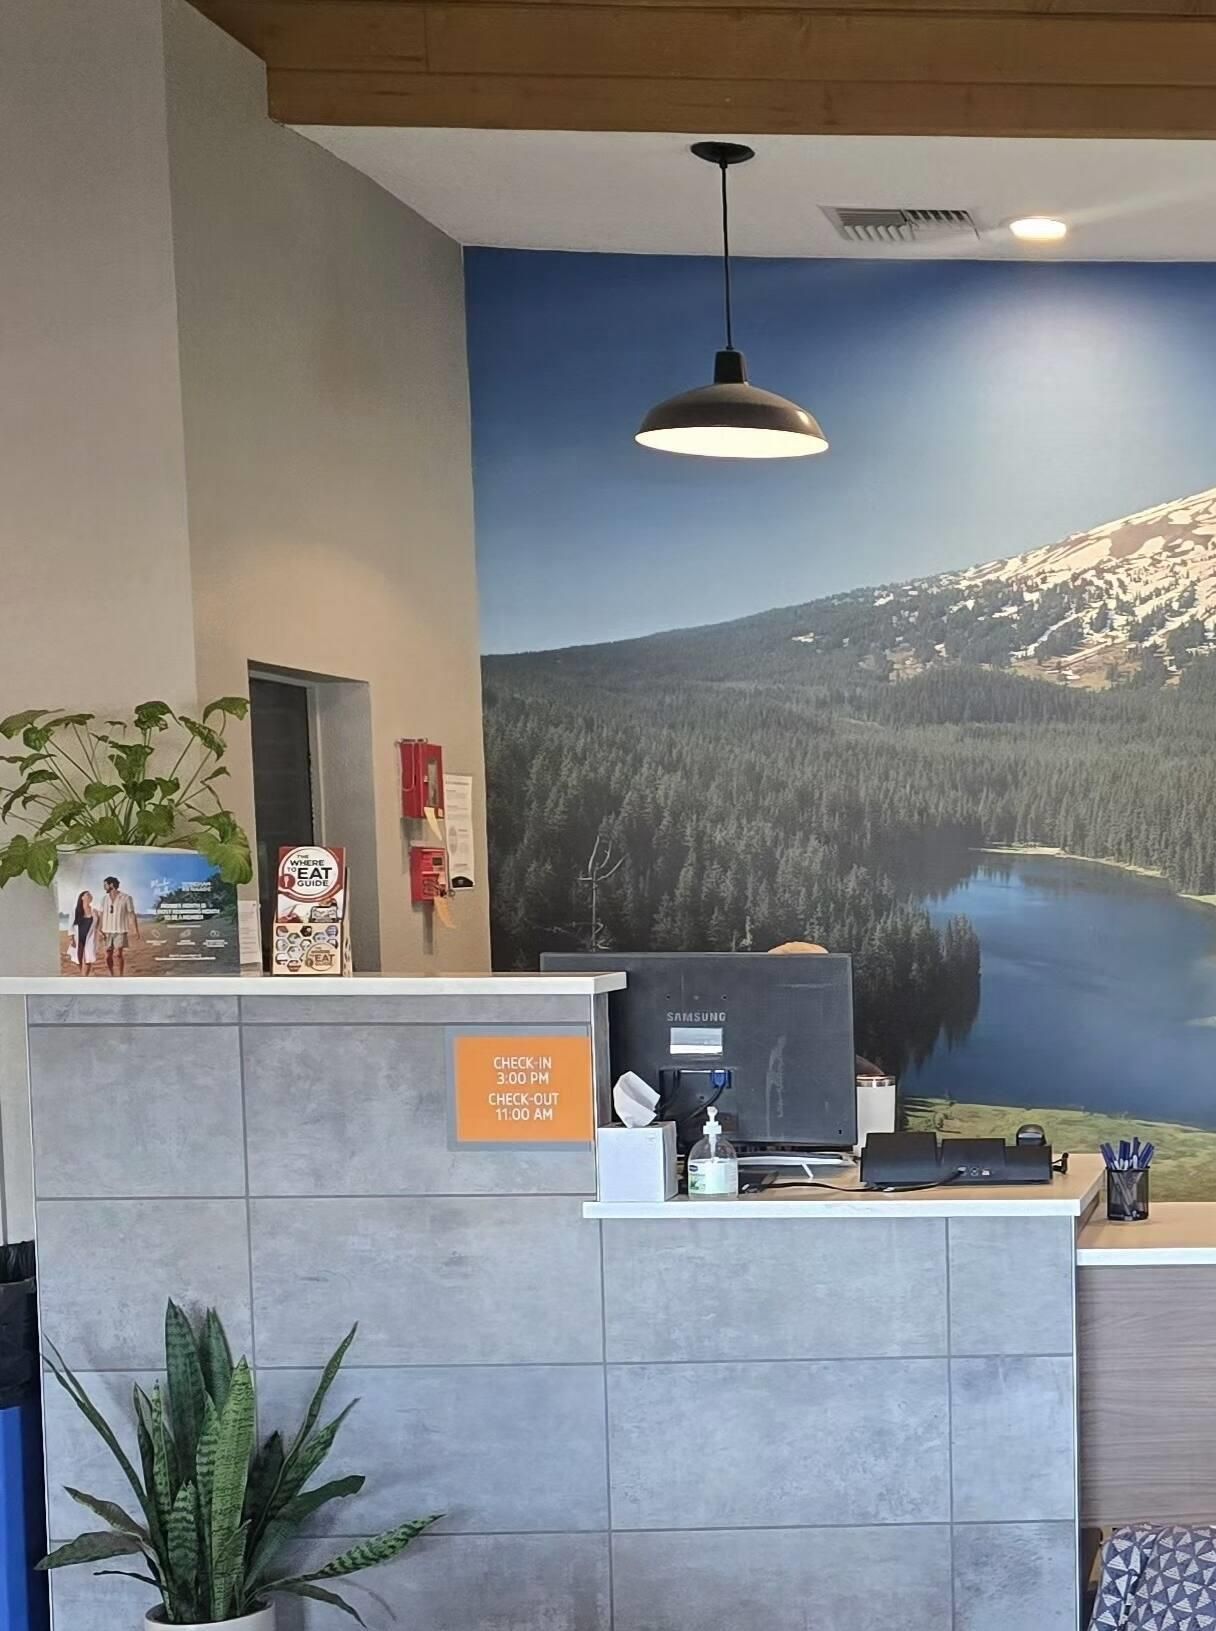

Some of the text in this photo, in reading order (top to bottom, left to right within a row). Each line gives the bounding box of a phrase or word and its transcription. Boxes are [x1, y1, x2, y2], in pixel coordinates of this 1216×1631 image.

[297, 867, 333, 879] EAT
[314, 953, 336, 963] EAT
[666, 1012, 727, 1022] SAMSUNG
[493, 1056, 552, 1069] CHECK-IN
[496, 1071, 549, 1085] 3:00 PM
[488, 1092, 560, 1106] CHECK-OUT
[495, 1108, 553, 1121] 11:00 AM
